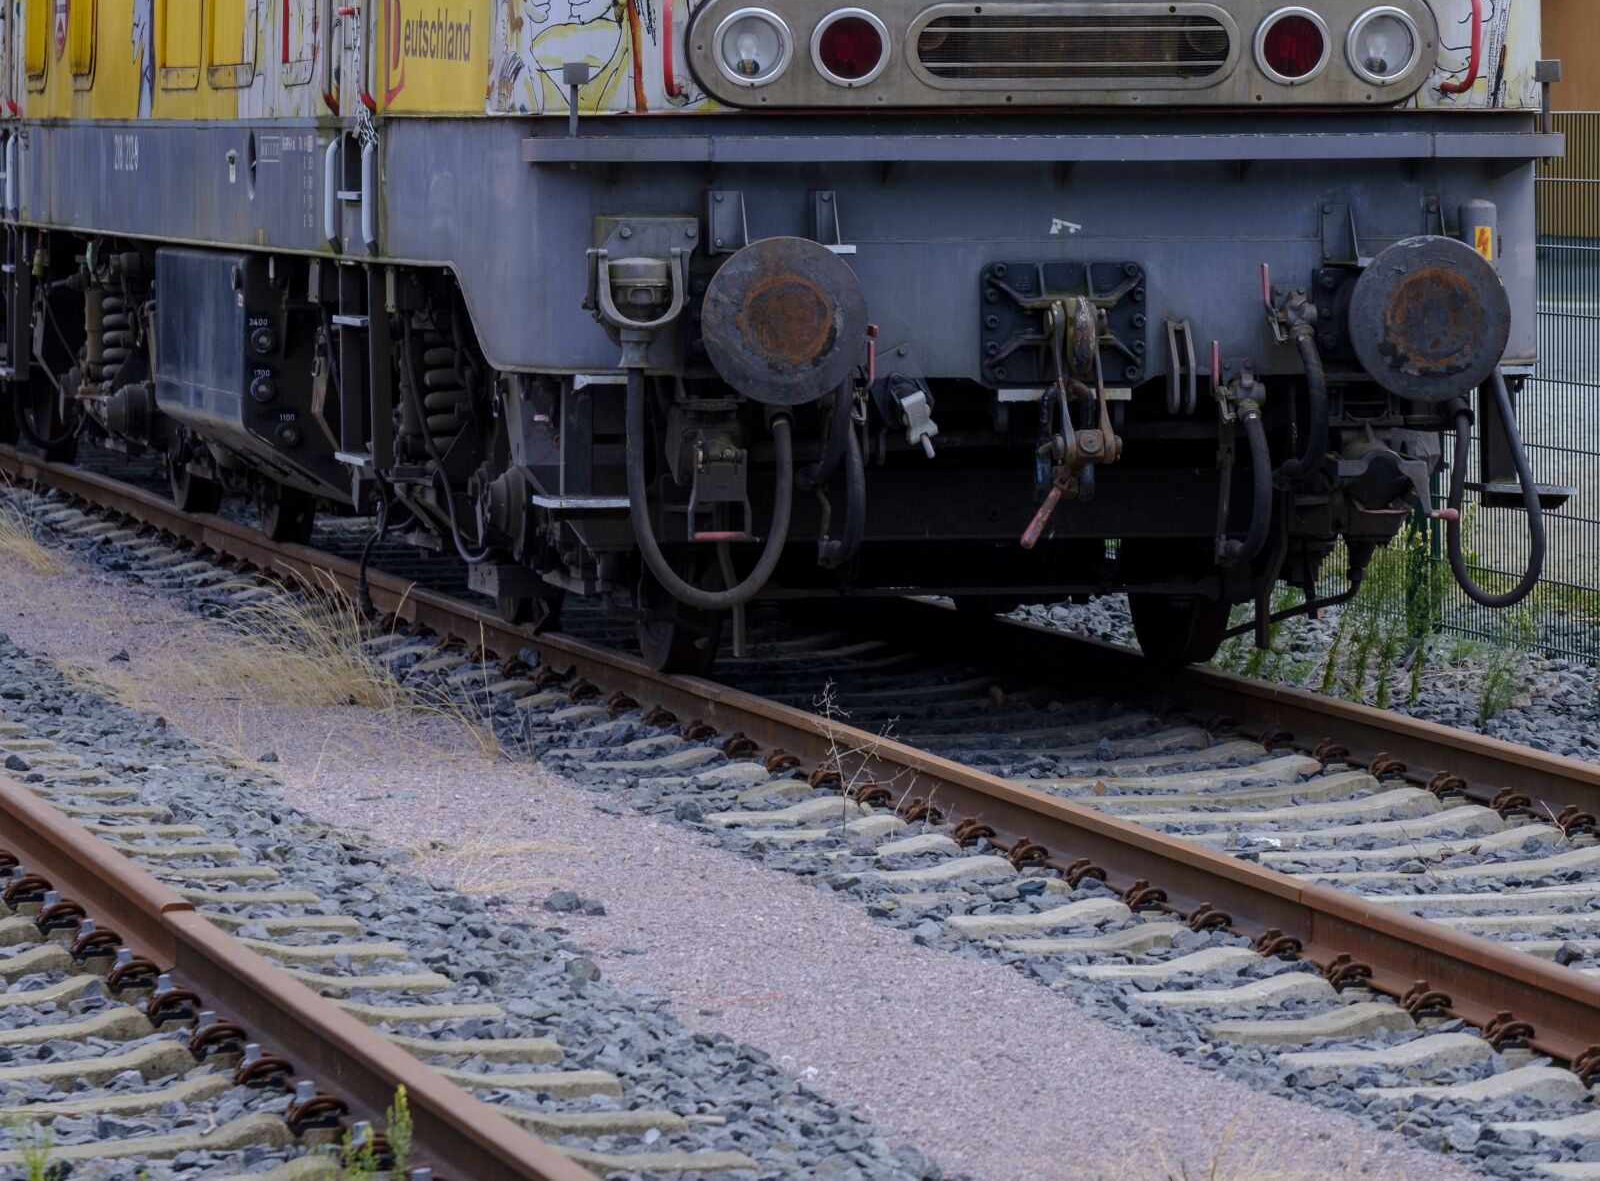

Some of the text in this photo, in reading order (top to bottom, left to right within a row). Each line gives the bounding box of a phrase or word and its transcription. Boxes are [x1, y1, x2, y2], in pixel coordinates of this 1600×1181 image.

[249, 318, 268, 327] 2400
[253, 369, 271, 377] 1700
[279, 413, 295, 422] 1100
